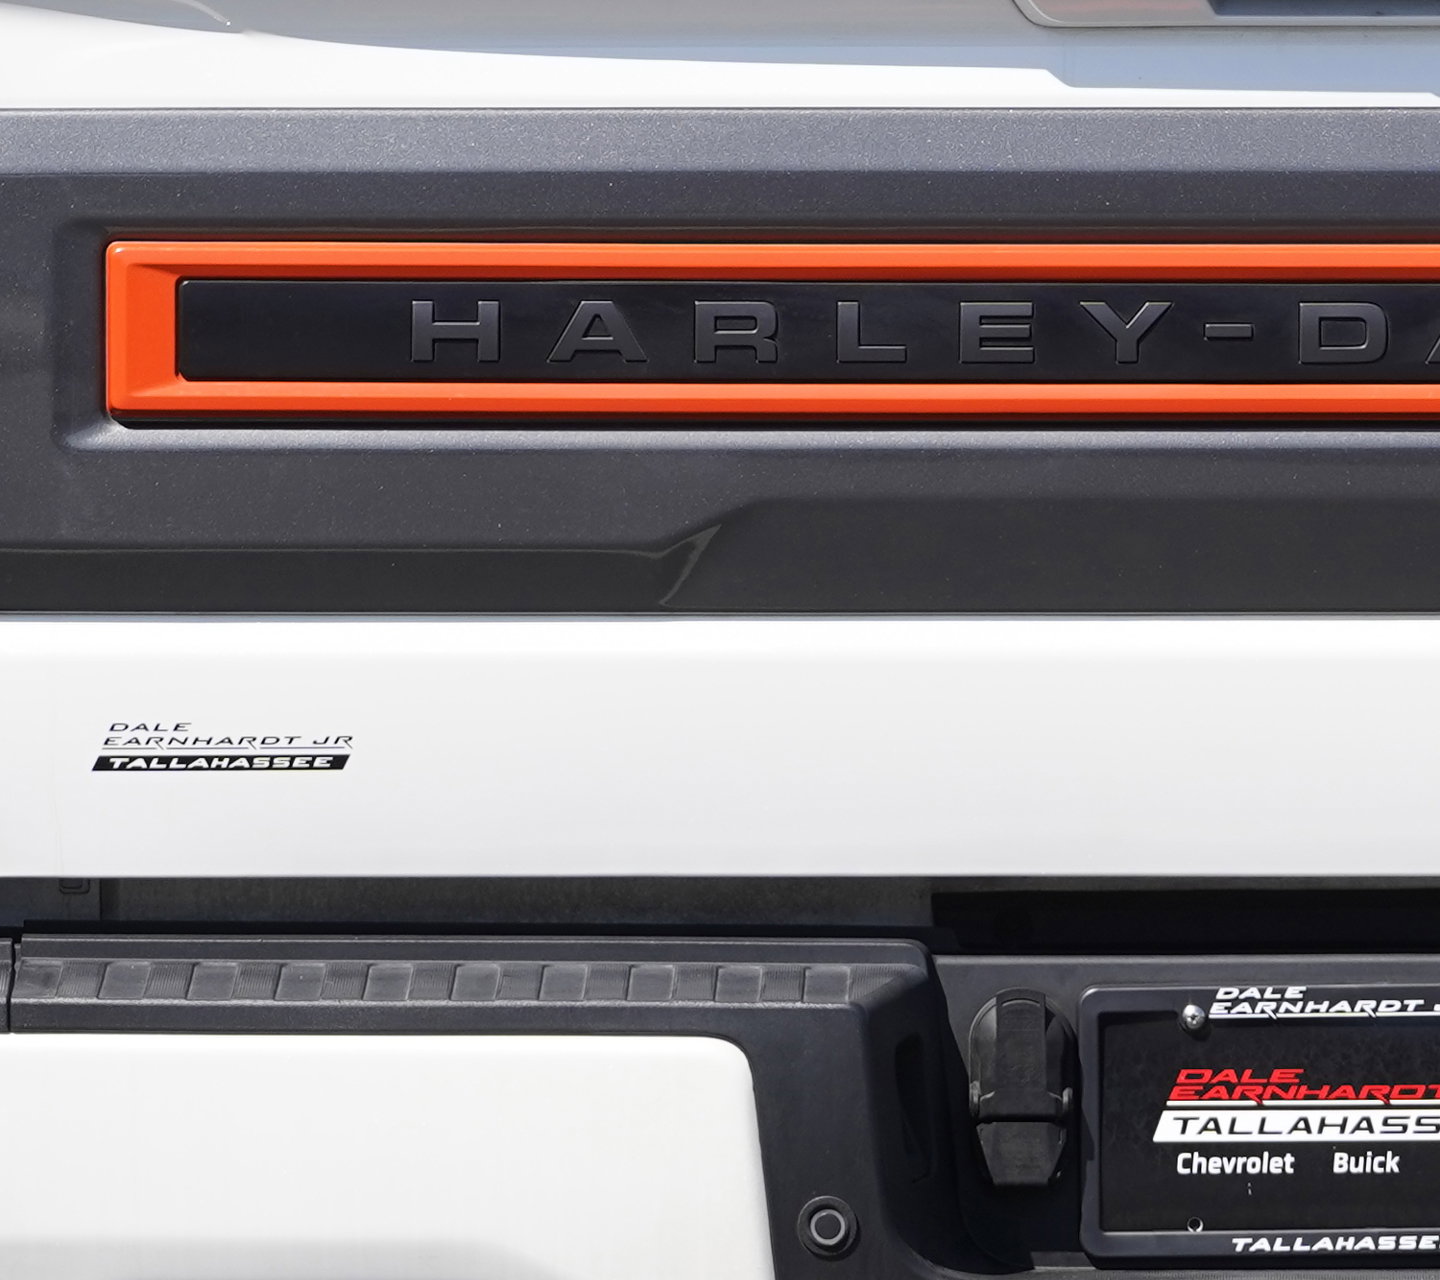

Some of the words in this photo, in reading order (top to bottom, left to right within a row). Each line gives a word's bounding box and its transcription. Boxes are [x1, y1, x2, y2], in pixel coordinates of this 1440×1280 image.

[109, 722, 192, 732] DALE
[103, 736, 302, 749] EARNHARDT
[313, 736, 353, 749] JR
[109, 756, 334, 769] TALLAHASSEE
[1215, 986, 1307, 1000] DALE
[1210, 1000, 1425, 1018] EARNHARDT
[1176, 1068, 1305, 1084] DALE
[1176, 1151, 1295, 1175] Chevrolet
[1332, 1151, 1401, 1175] Buick
